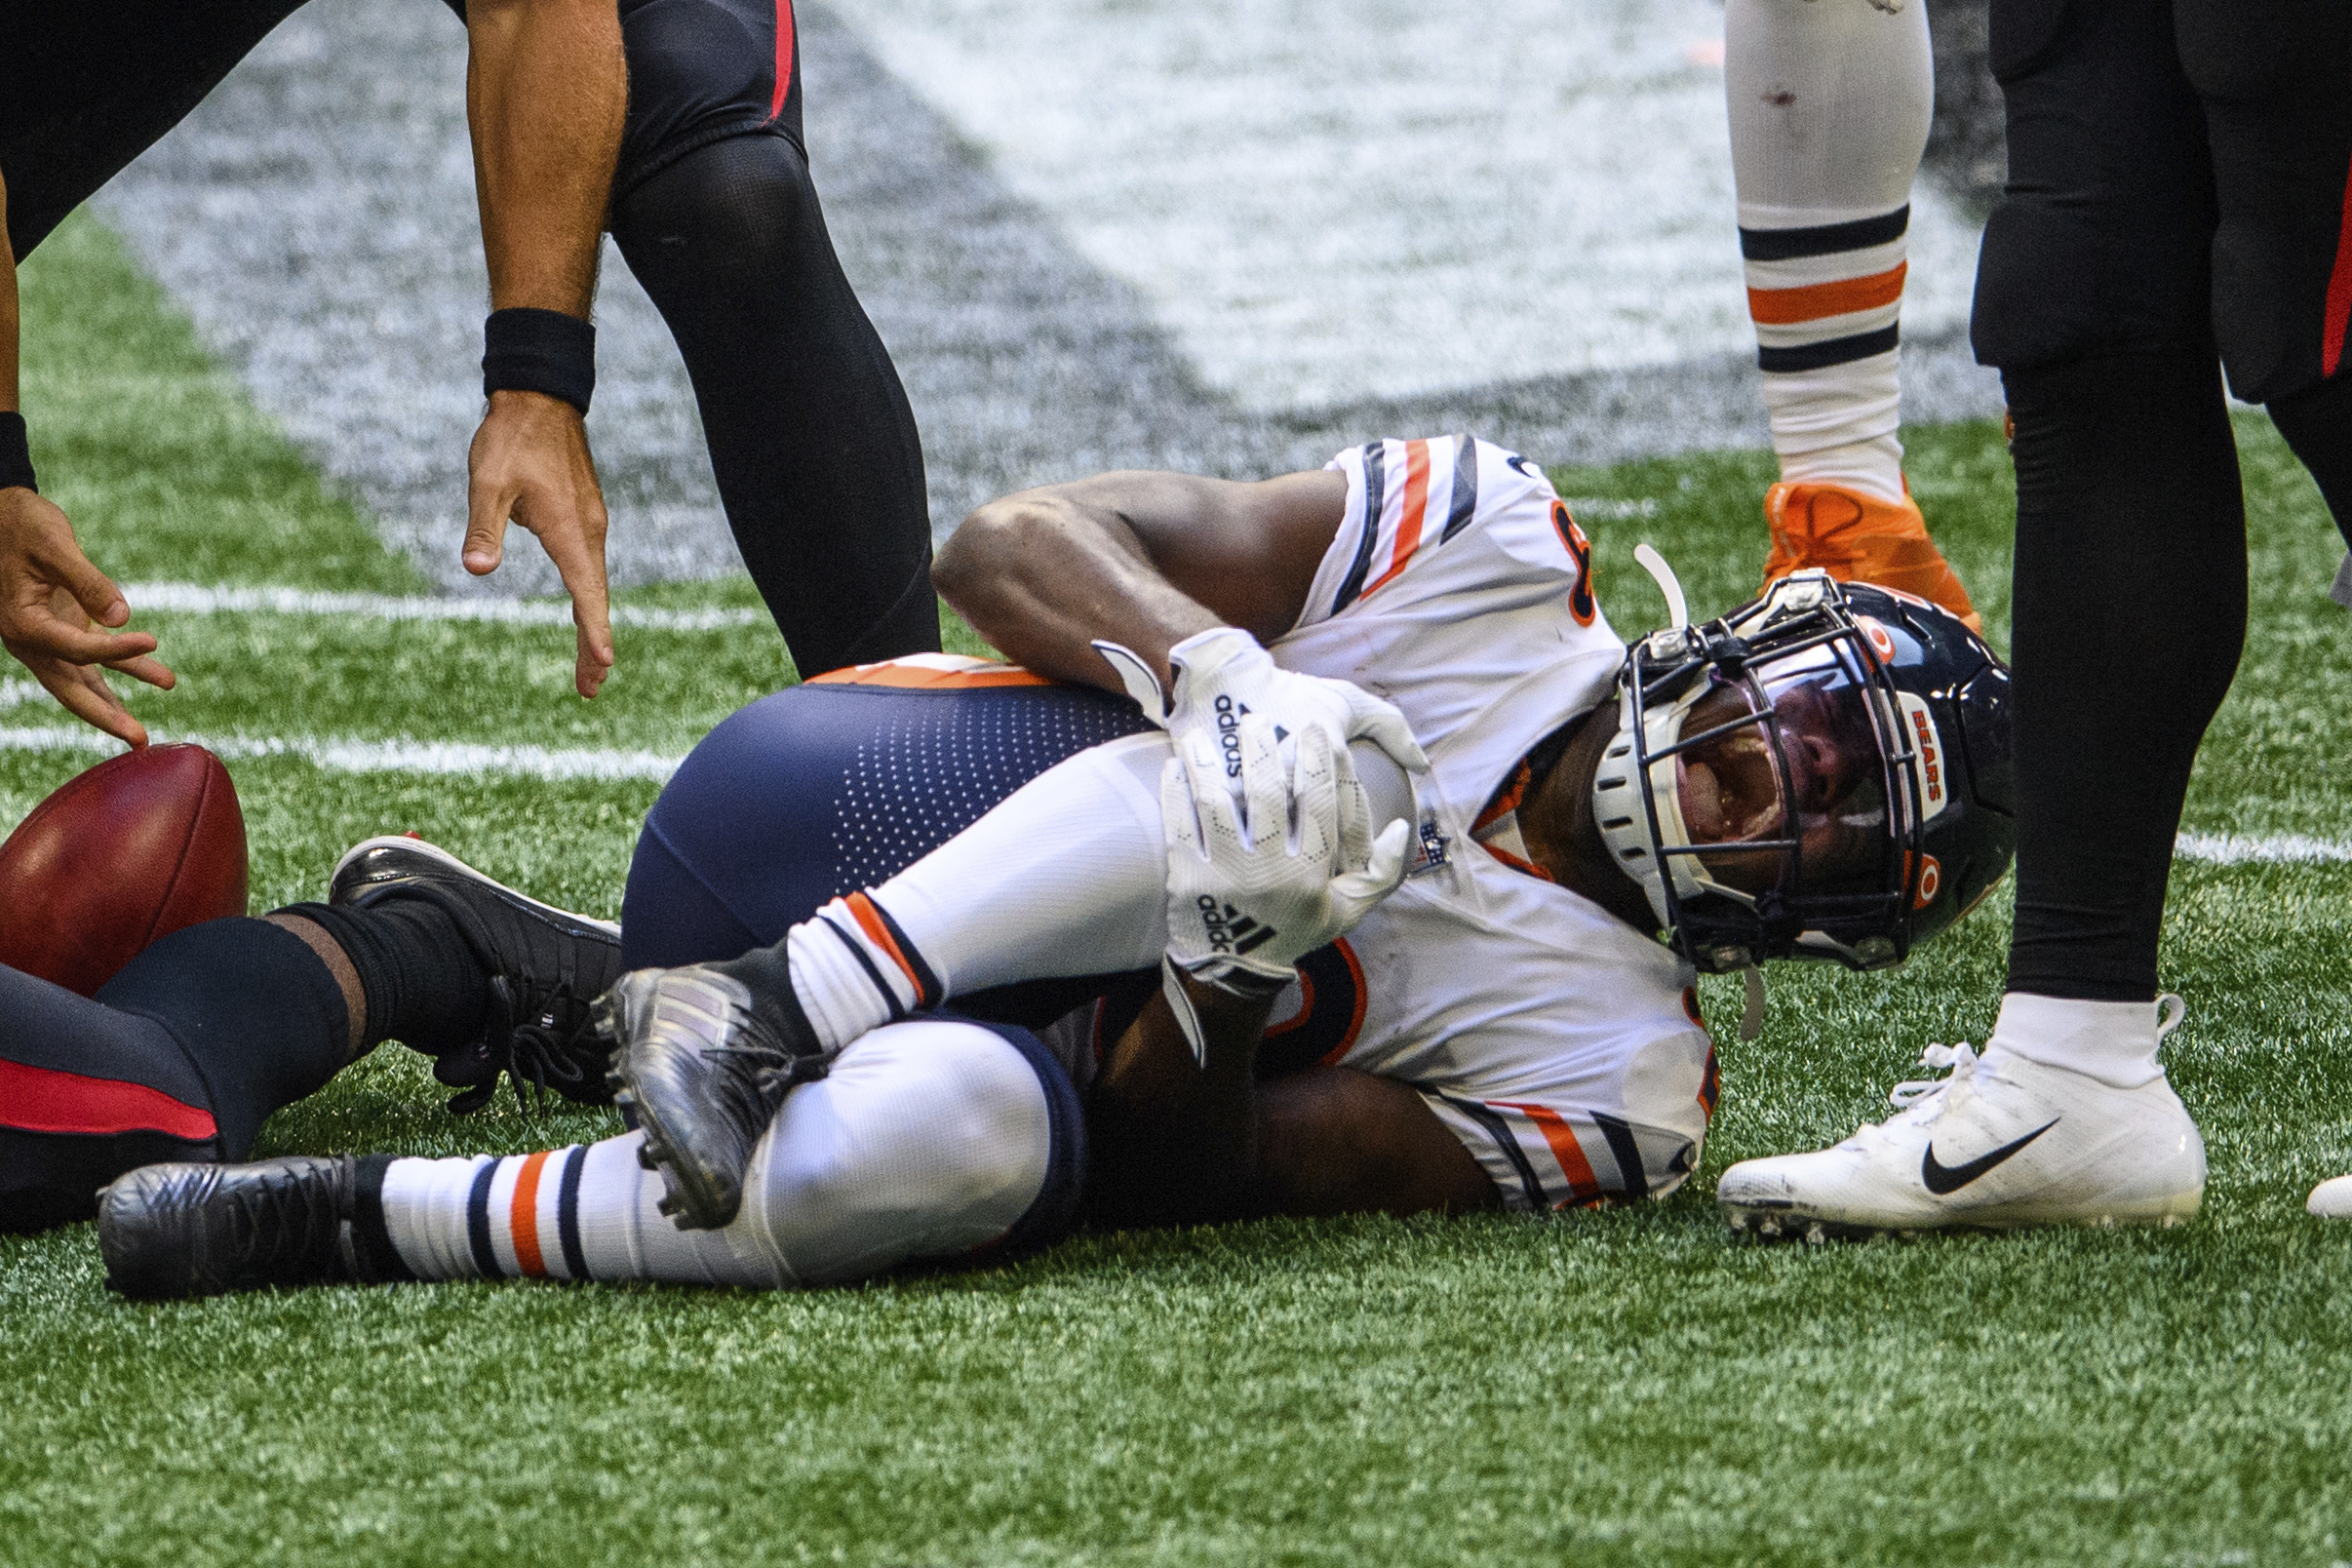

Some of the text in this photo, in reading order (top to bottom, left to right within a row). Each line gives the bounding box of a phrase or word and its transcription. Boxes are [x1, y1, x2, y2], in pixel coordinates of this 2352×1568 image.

[1213, 694, 1243, 778] adidas
[1911, 710, 1941, 802] BEARS
[1196, 894, 1234, 954] adid
